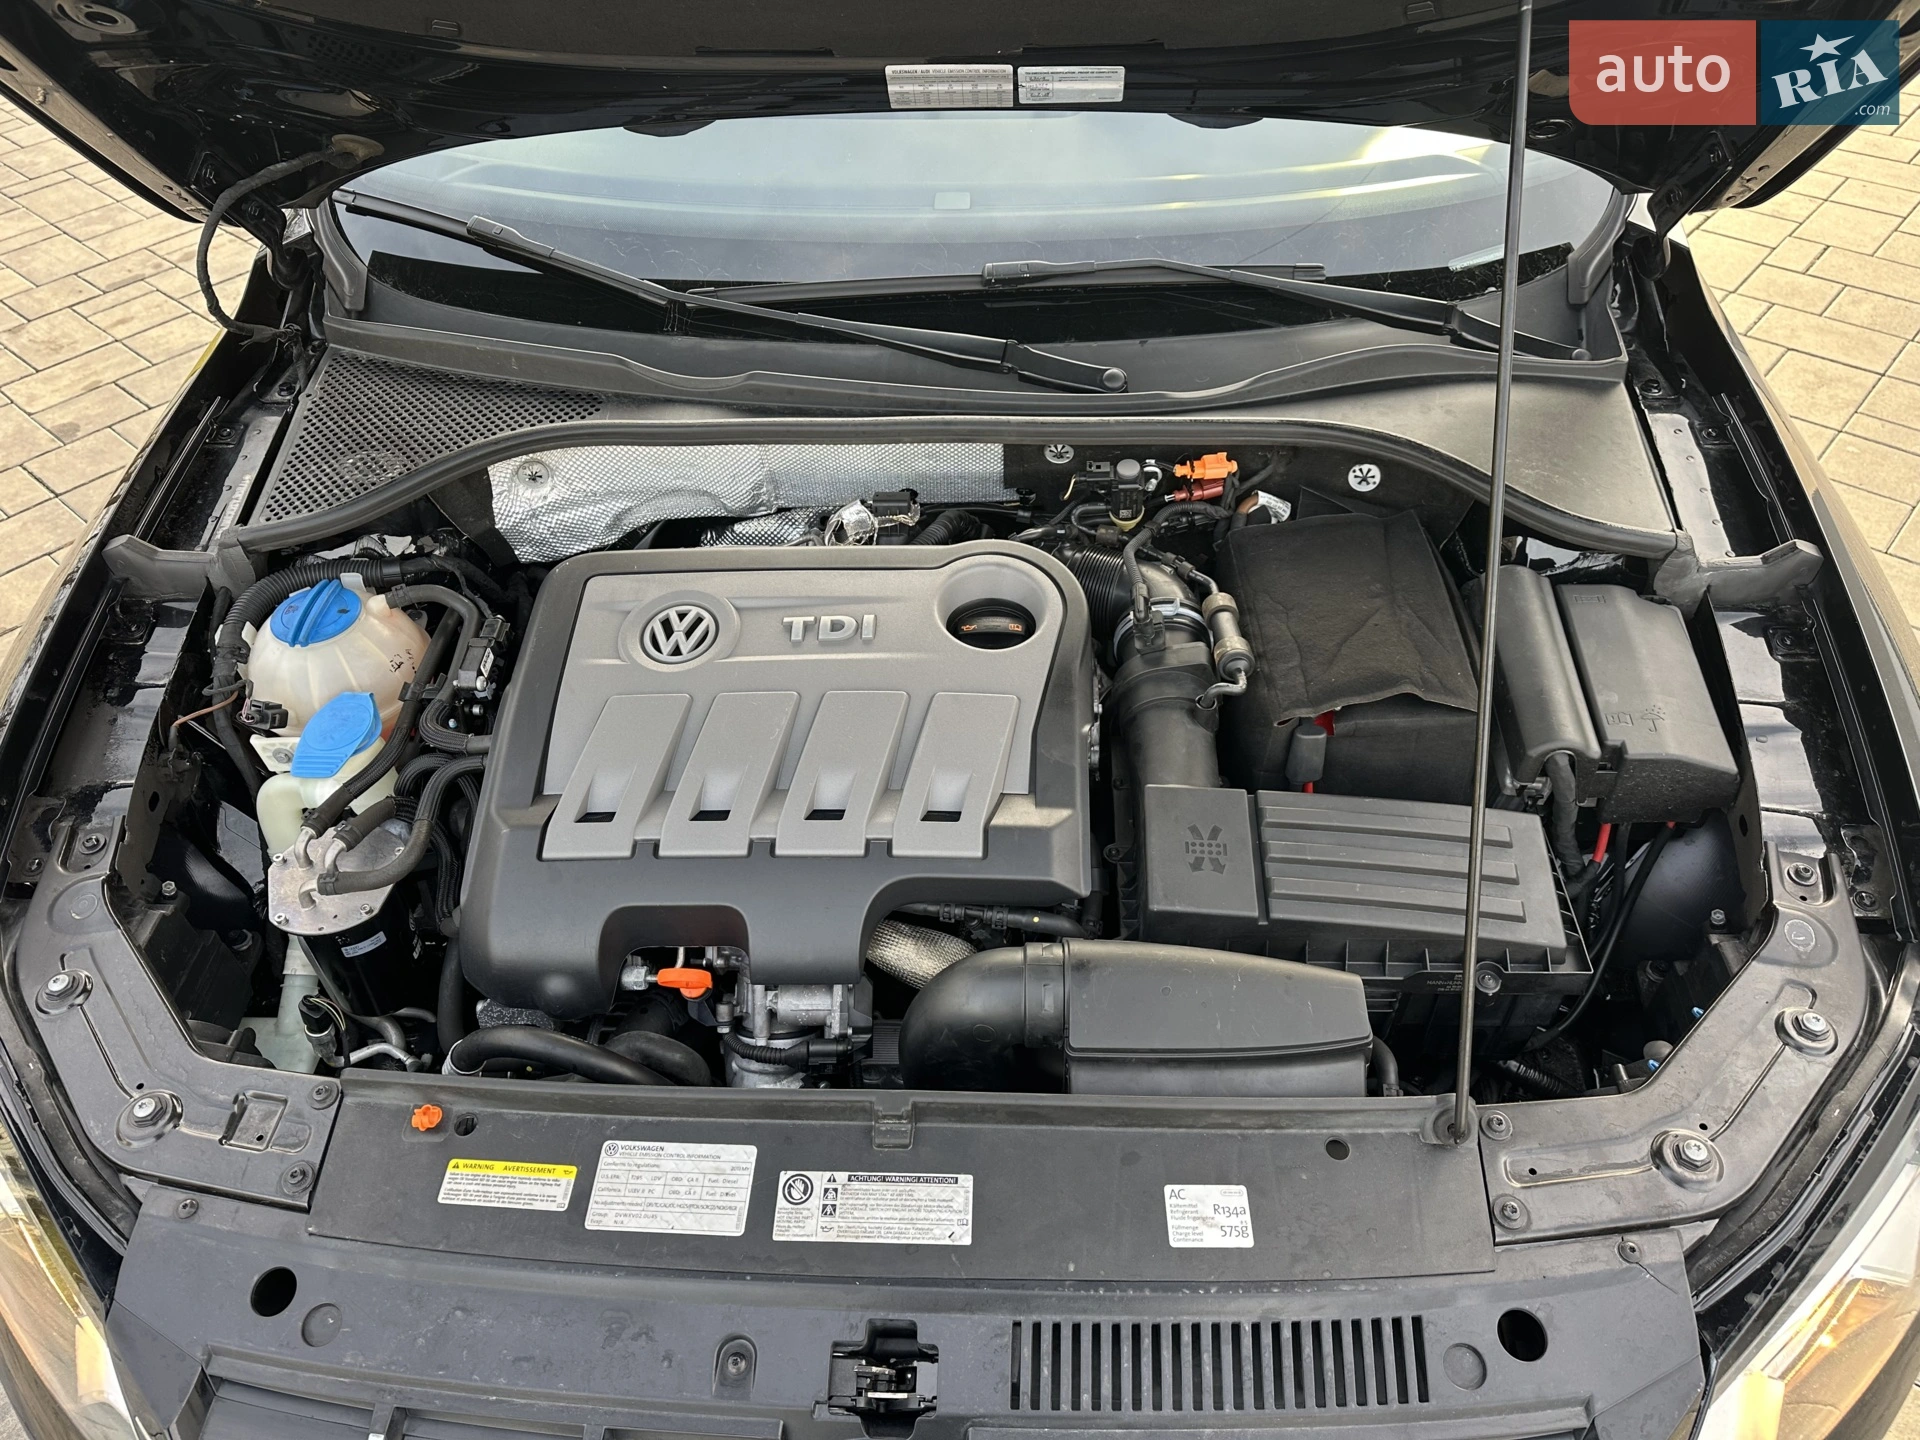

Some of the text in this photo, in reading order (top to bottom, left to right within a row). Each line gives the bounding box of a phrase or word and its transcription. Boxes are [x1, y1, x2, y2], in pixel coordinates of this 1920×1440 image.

[782, 614, 876, 642] TDI
[503, 1165, 556, 1174] AVERTISSEMENT
[1169, 1188, 1186, 1200] AC
[1213, 1204, 1246, 1218] R134a
[1220, 1226, 1249, 1238] 575g
